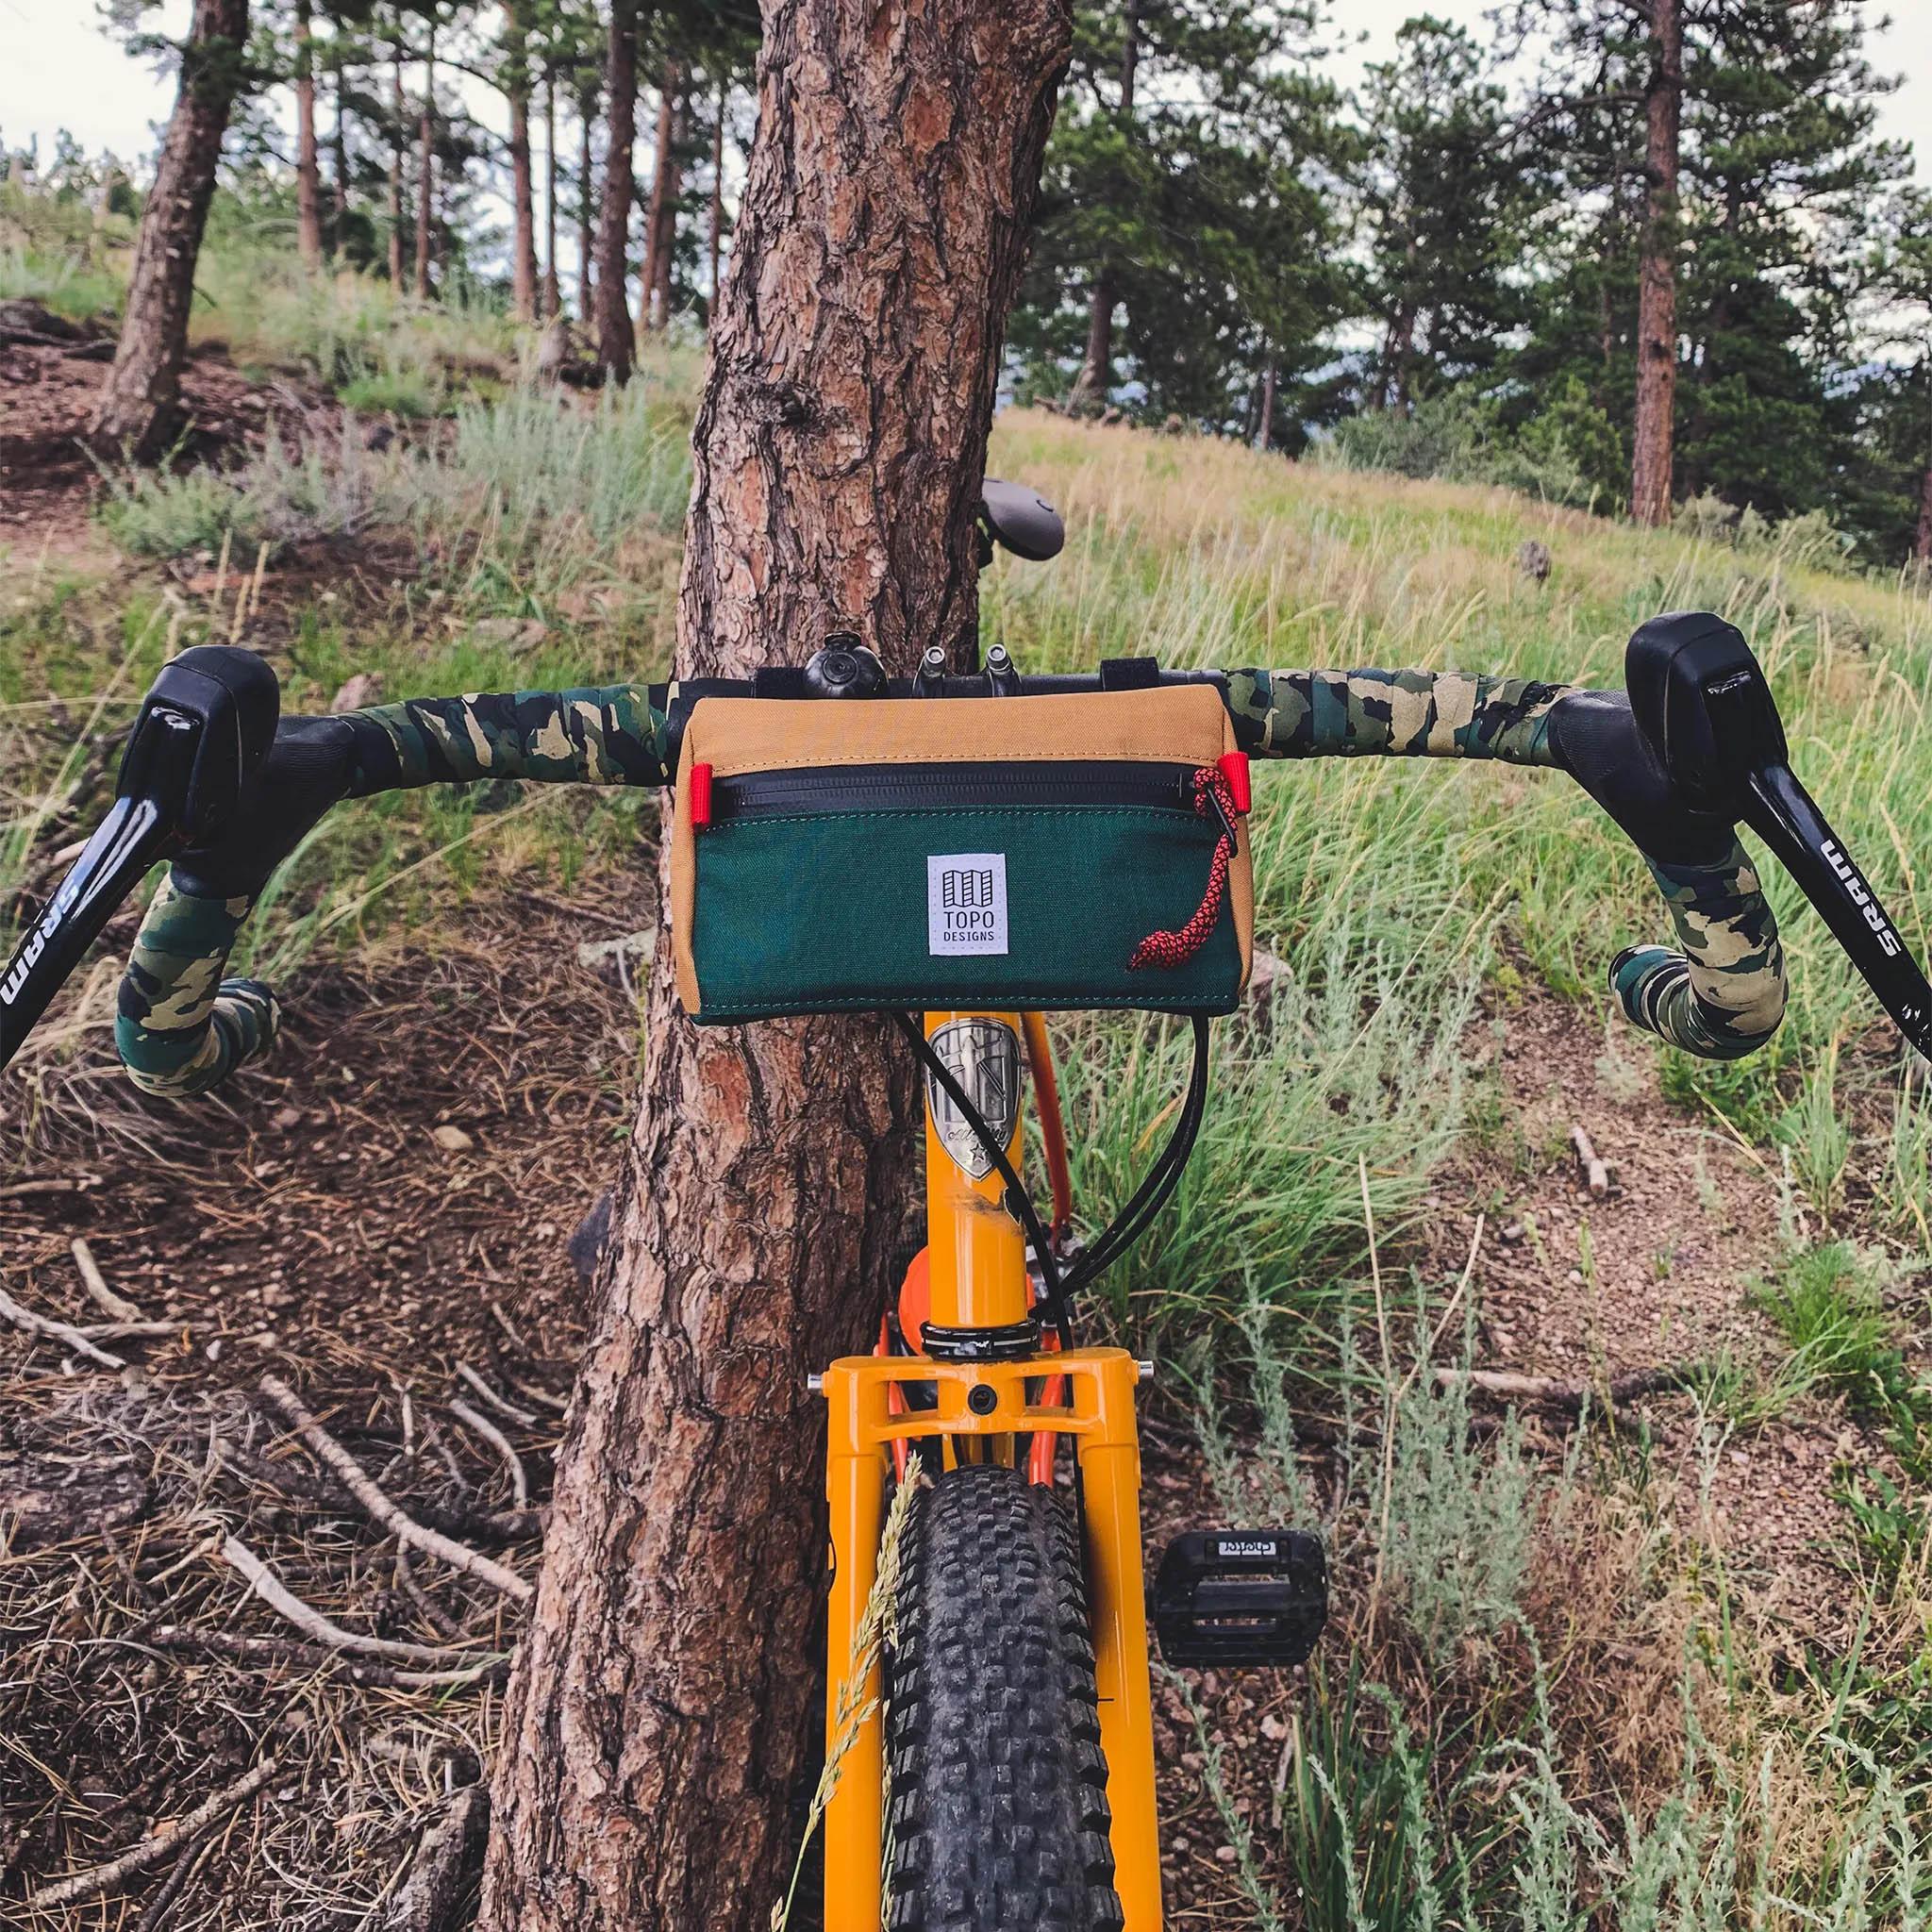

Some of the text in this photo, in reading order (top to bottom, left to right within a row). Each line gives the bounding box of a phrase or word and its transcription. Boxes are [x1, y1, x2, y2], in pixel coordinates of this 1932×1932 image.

[943, 910, 994, 929] TOPO
[1821, 840, 1902, 957] SRAM
[0, 884, 80, 1005] SRAM
[943, 931, 994, 941] DESIGNS
